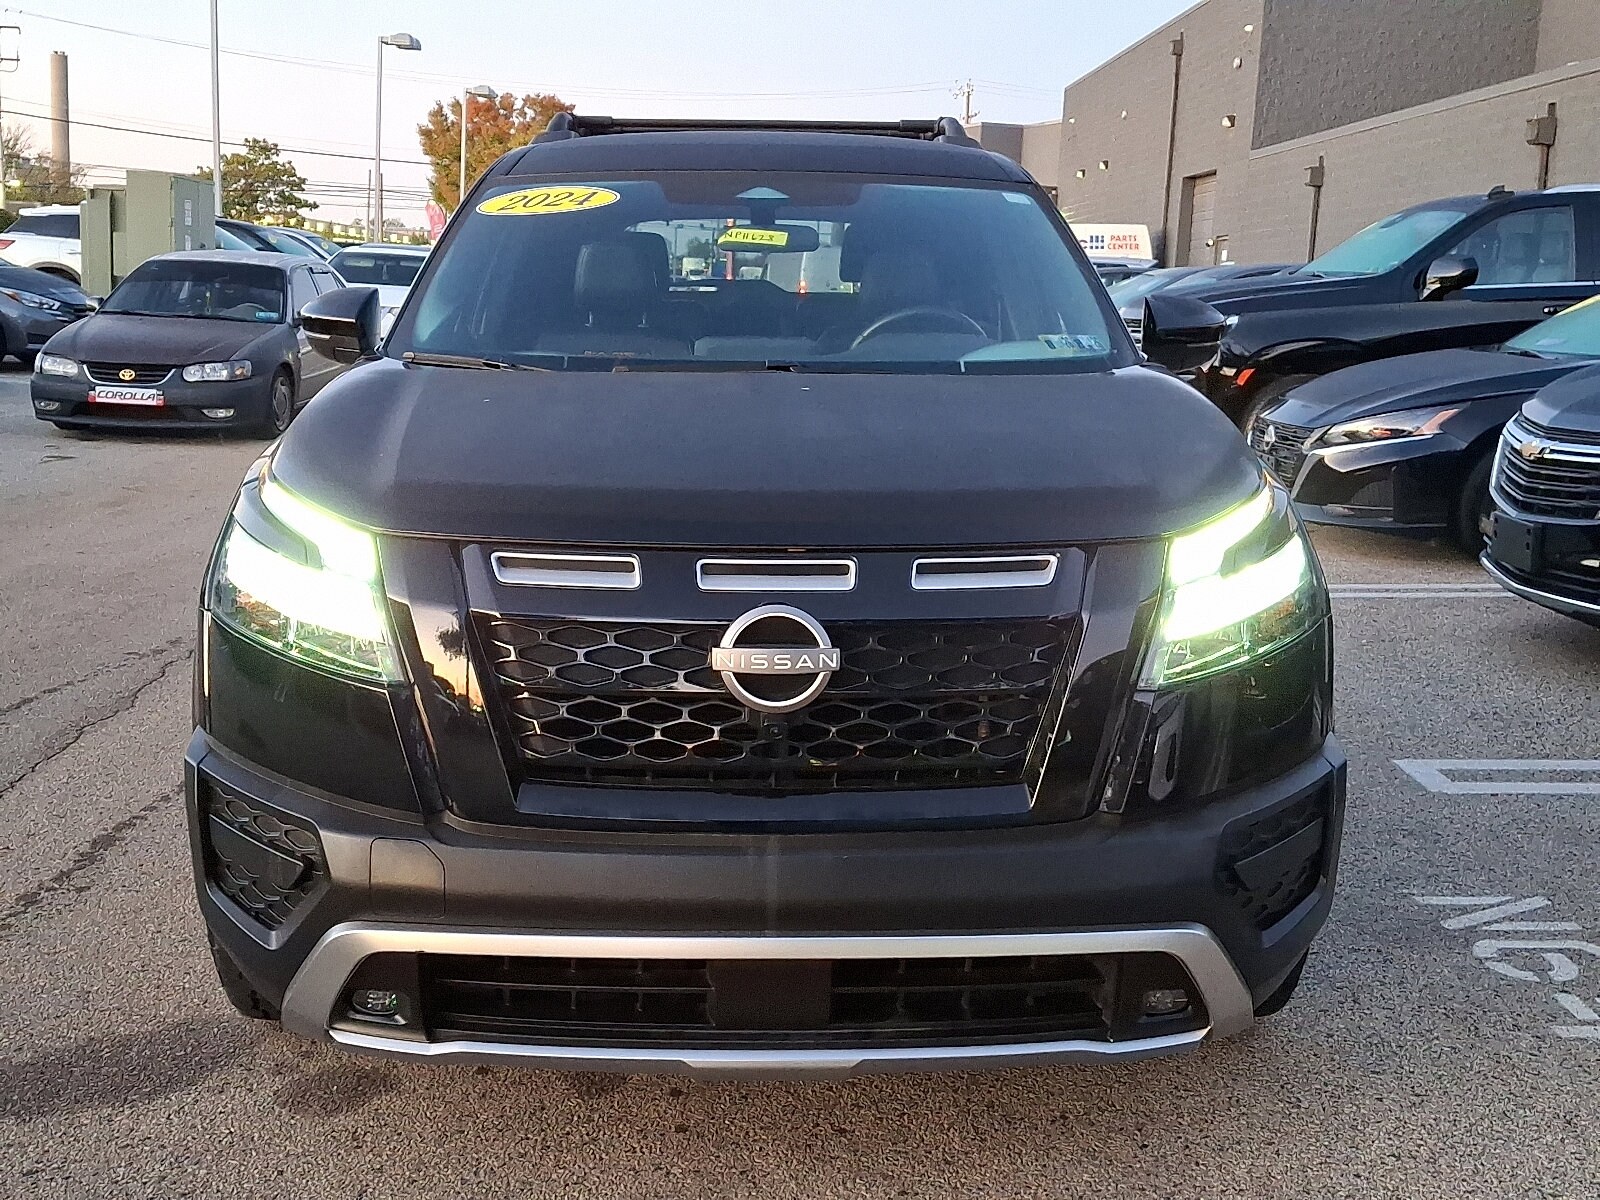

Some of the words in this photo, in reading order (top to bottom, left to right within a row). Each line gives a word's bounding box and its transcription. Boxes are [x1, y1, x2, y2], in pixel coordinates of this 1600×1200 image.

[496, 191, 599, 212] 2024
[1110, 234, 1137, 242] PARTS
[1107, 242, 1140, 250] CENTER
[96, 390, 156, 402] COROLLA
[716, 651, 837, 670] NISSAN
